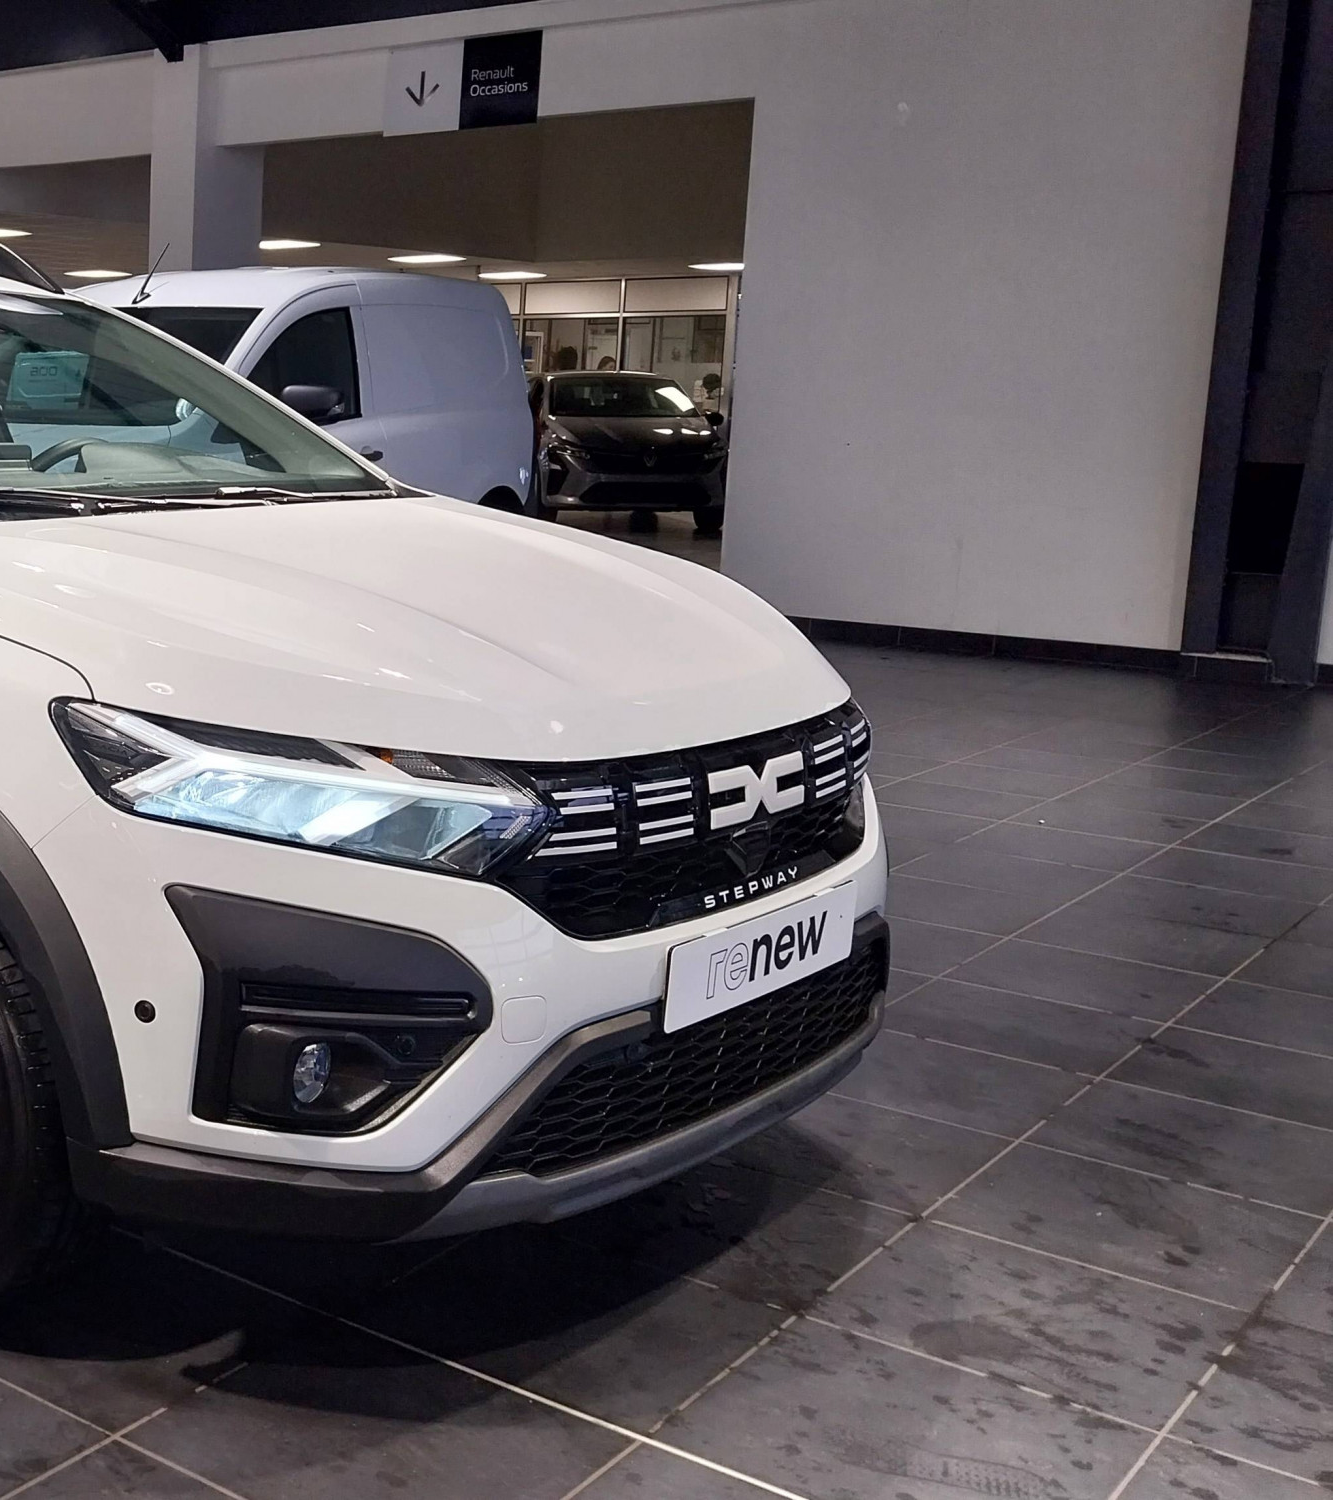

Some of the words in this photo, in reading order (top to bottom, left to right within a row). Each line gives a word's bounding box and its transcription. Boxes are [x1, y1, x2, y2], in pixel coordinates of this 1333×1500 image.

[471, 65, 515, 81] Renault
[470, 81, 529, 97] Occasions
[704, 866, 798, 908] STEPWAY
[706, 910, 828, 1000] renew
